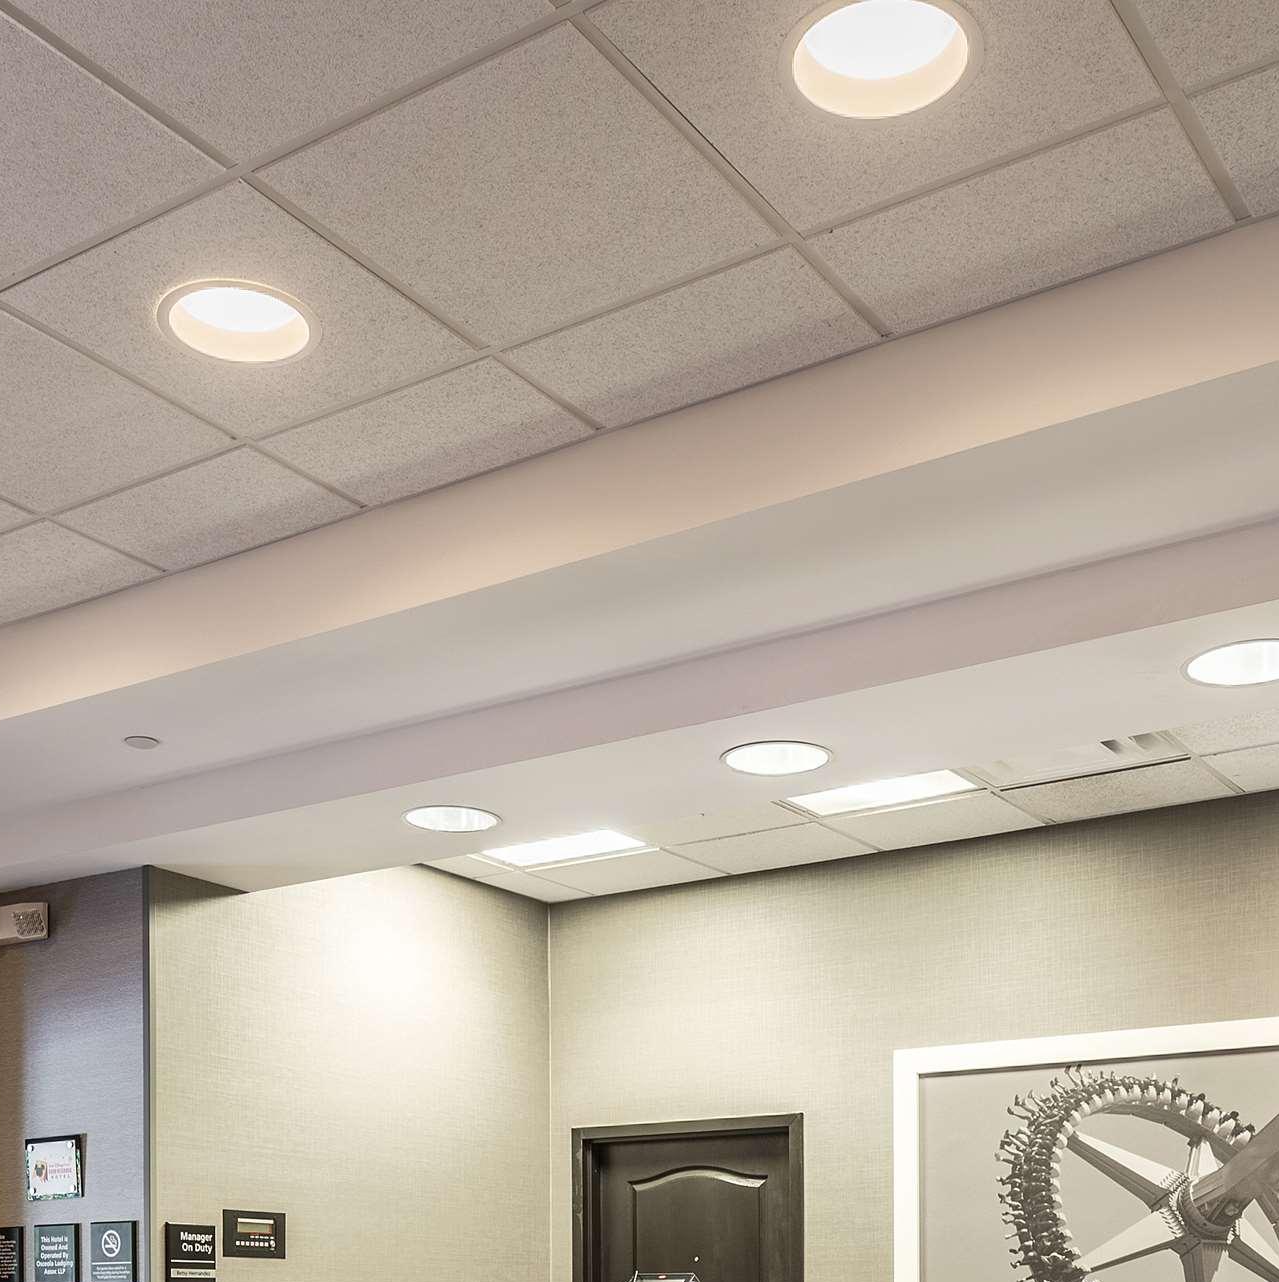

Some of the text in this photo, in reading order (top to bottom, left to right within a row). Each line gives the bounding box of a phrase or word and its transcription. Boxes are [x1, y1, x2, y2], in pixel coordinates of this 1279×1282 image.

[180, 1231, 213, 1244] Manager
[181, 1242, 213, 1255] On Duty
